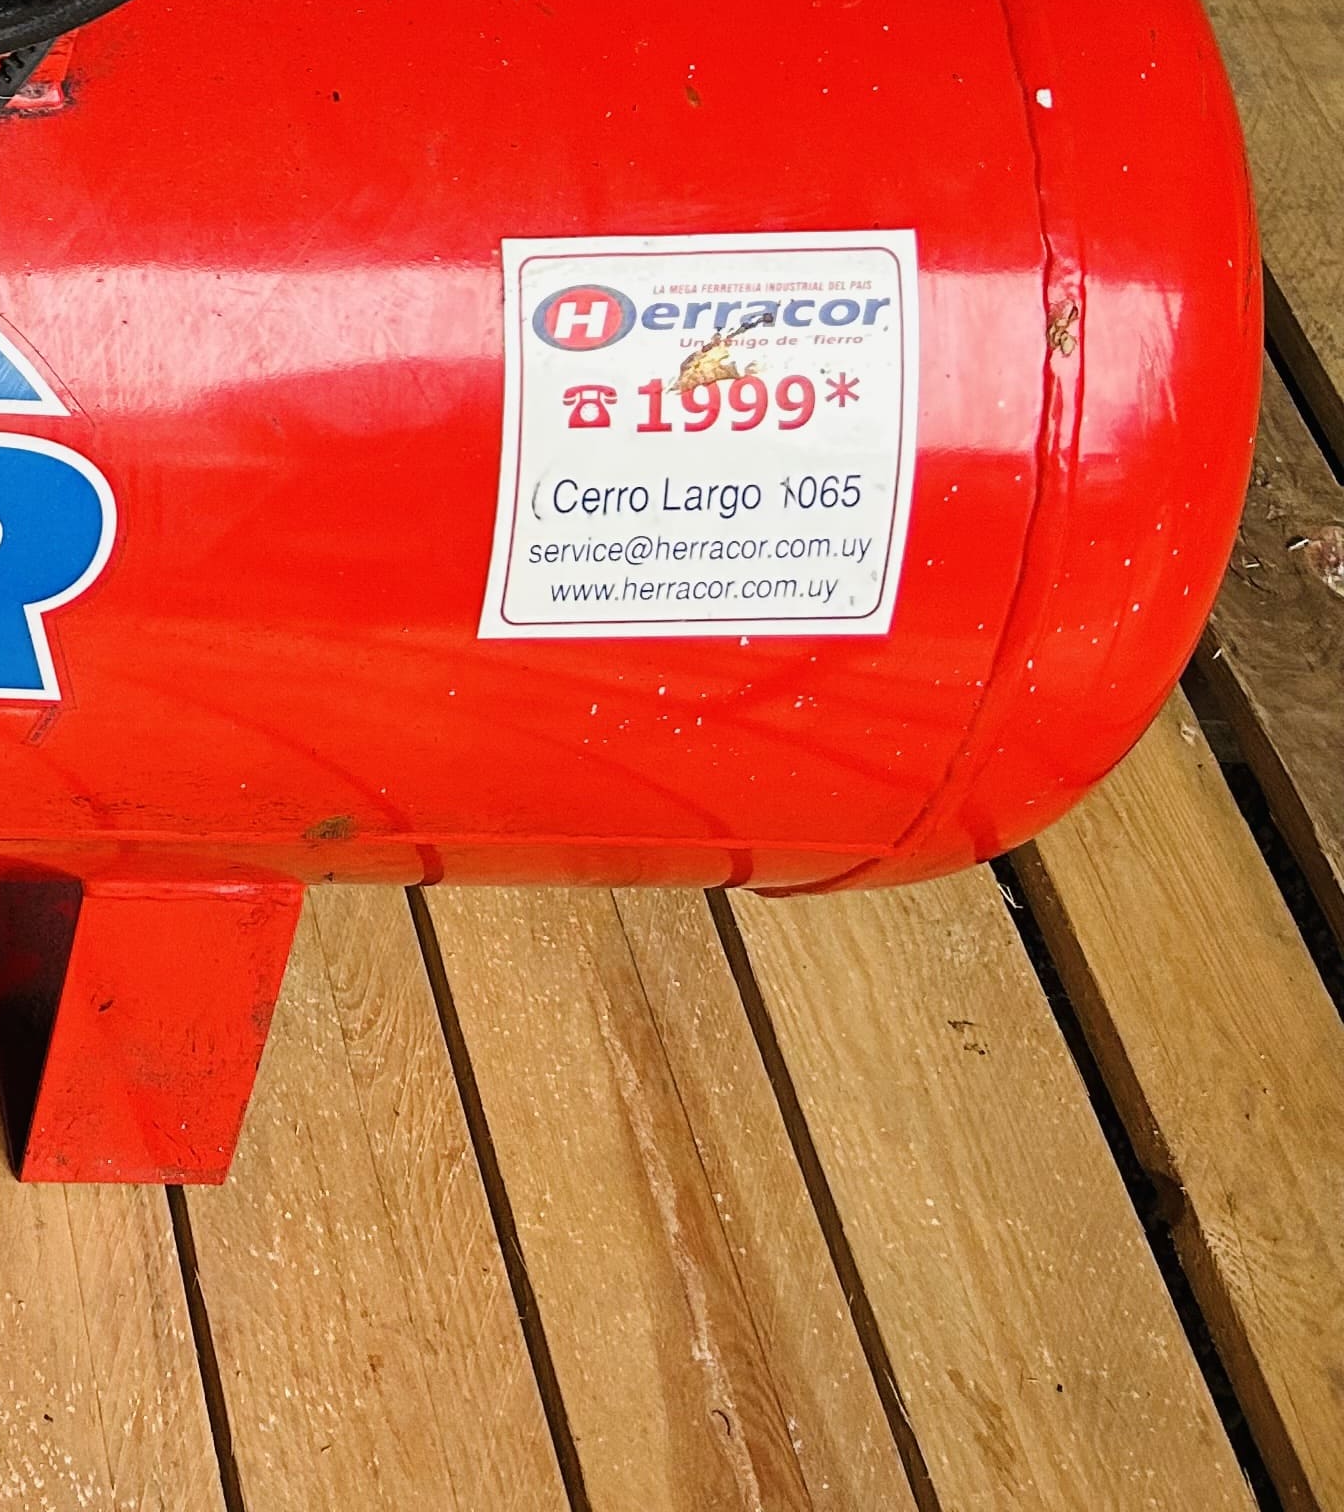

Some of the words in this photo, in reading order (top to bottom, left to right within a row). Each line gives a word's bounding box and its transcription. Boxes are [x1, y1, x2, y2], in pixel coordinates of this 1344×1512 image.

[653, 285, 666, 295] LA
[669, 284, 698, 294] MEGA
[701, 281, 762, 294] FERRETERIA
[765, 279, 823, 293] INDUSTRIAL
[828, 281, 846, 291] DEL
[849, 279, 873, 291] PAIS
[775, 336, 799, 346] de
[553, 478, 649, 515] Cerro
[662, 476, 762, 519] Largo
[779, 475, 862, 510] 1065
[528, 535, 873, 566] service@herracor.com.uy
[550, 576, 840, 604] www.herracor.com.uy
